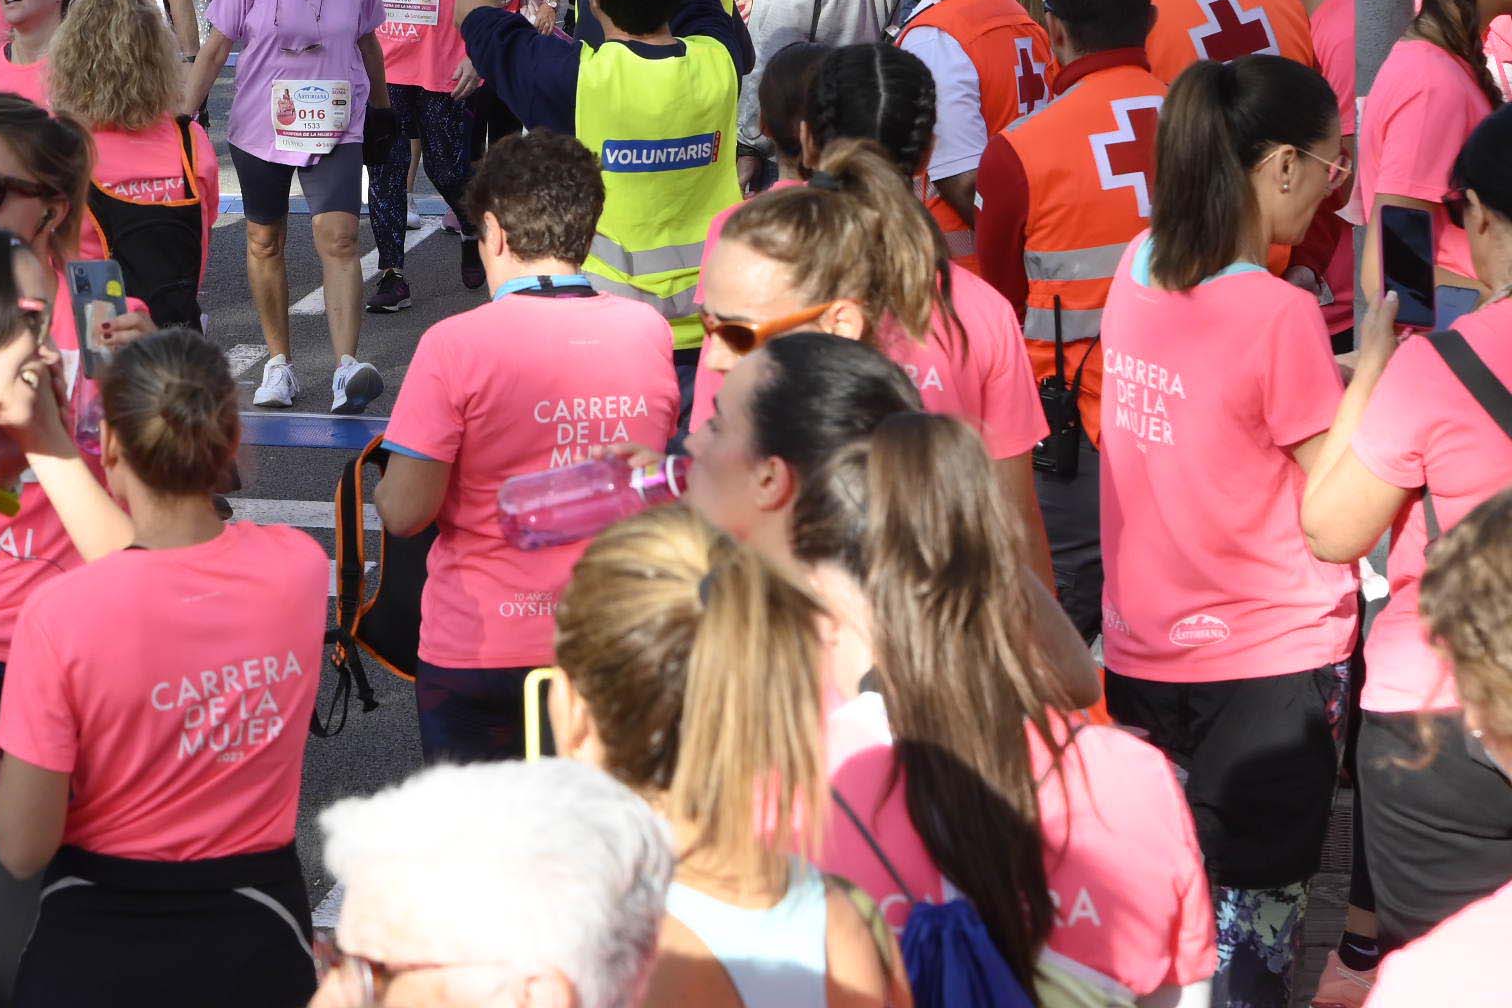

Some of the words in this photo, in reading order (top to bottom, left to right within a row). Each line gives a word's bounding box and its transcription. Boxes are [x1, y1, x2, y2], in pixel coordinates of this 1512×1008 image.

[376, 22, 419, 38] UMA
[298, 109, 326, 120] 016
[303, 122, 321, 130] 1533
[605, 142, 712, 165] VOLUNTARIS
[1104, 347, 1187, 399] CARRERA
[533, 395, 649, 423] CARRERA
[1116, 378, 1136, 408] DE
[1143, 388, 1168, 417] LA
[557, 421, 590, 446] DE
[600, 420, 630, 442] LA
[1115, 407, 1176, 446] MUJER
[151, 651, 303, 712] CARRERA
[184, 704, 227, 730] DE
[238, 695, 280, 719] LA
[176, 715, 286, 760] MUJER
